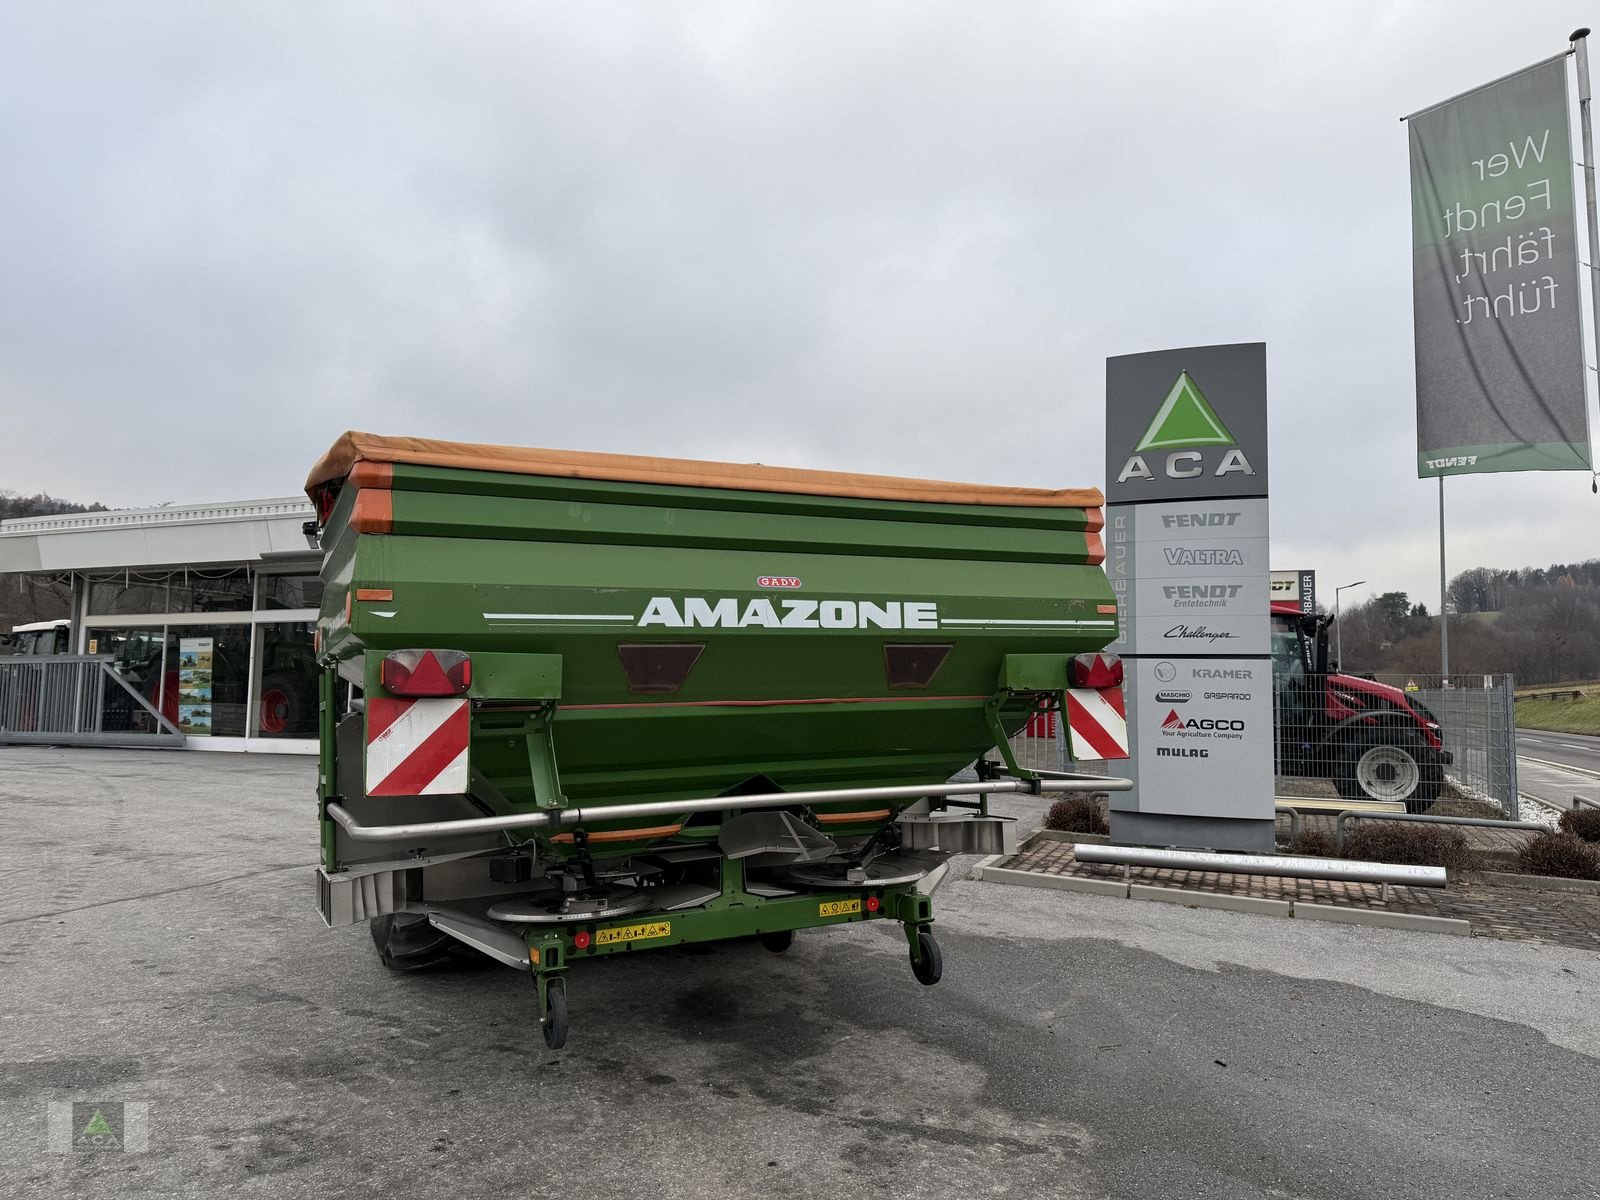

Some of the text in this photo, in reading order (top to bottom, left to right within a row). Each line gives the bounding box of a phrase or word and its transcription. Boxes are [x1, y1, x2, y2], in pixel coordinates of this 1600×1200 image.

[1116, 449, 1256, 483] ACA
[1161, 512, 1241, 528] FENDT
[1163, 548, 1243, 565] VALTRA
[761, 578, 796, 586] GADY
[1162, 584, 1243, 599] FENDT
[1173, 599, 1228, 608] Erntetechnik
[637, 597, 938, 629] AMAZONE
[1163, 624, 1241, 643] Challenger
[1192, 668, 1253, 679] KRAMER
[1204, 692, 1251, 701] GASPARDO
[1186, 718, 1245, 731] AGCO
[1213, 731, 1243, 740] Company
[1156, 747, 1209, 758] MULAG
